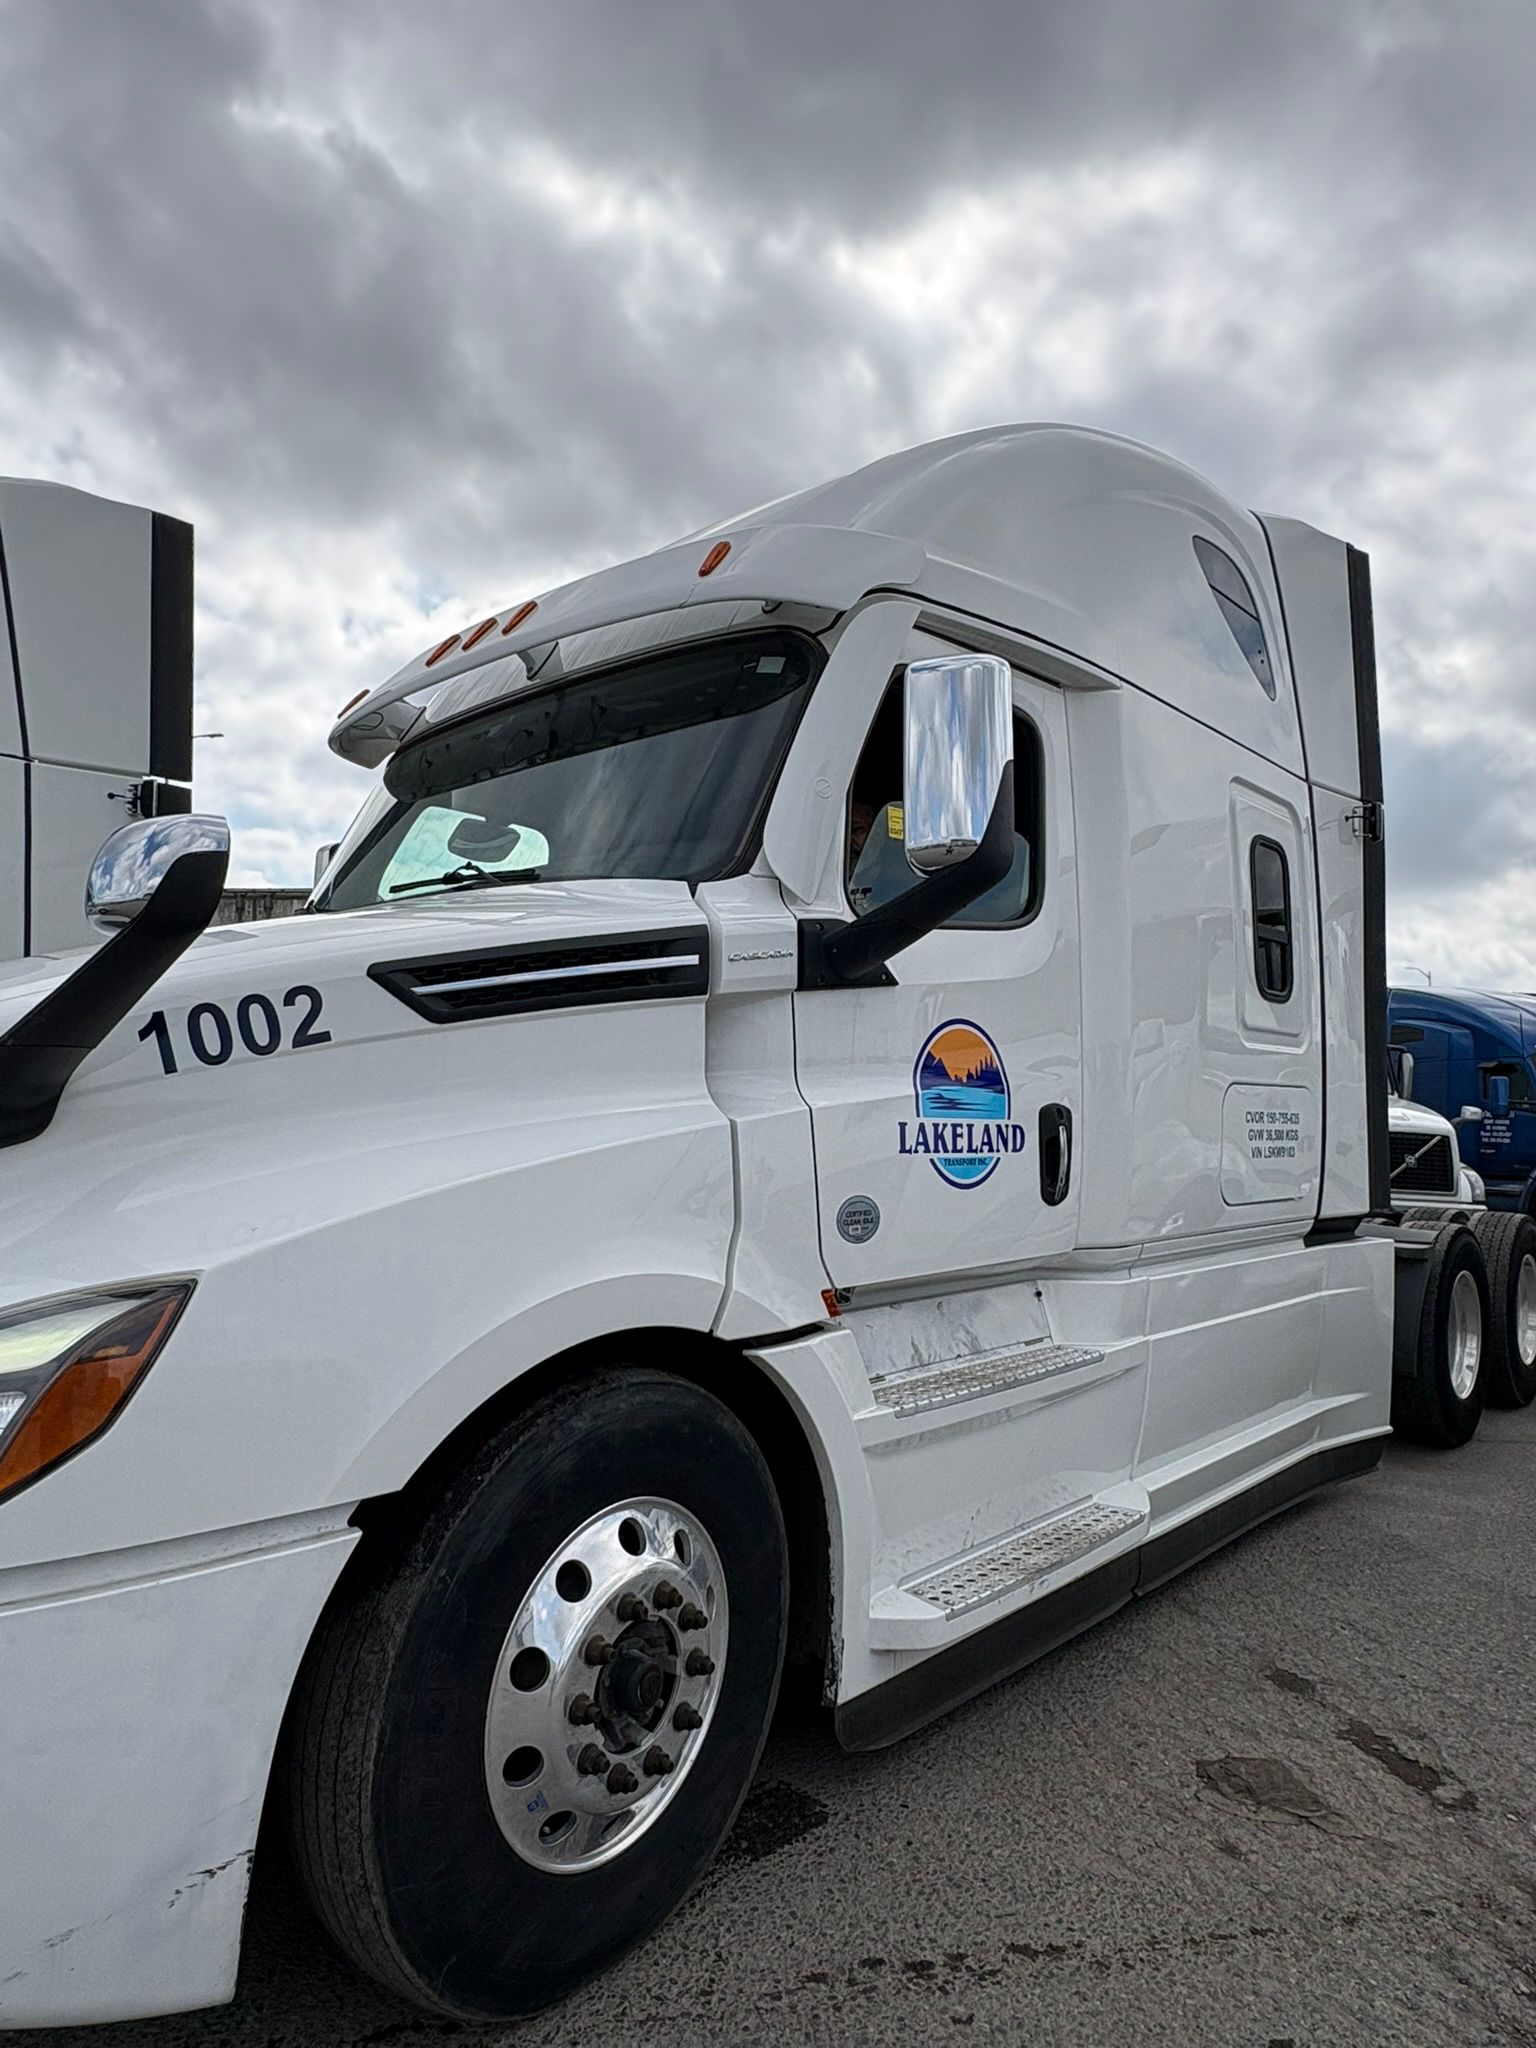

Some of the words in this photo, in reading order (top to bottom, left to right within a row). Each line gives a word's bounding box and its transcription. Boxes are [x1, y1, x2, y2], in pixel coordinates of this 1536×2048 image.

[728, 949, 794, 962] CASCADIA
[137, 985, 332, 1075] 1002
[1245, 1111, 1265, 1124] CVOR
[898, 1122, 1026, 1155] LAKELAND
[1248, 1129, 1264, 1141] GVW
[1286, 1129, 1299, 1141] KGS
[1251, 1146, 1263, 1159] VIN
[943, 1157, 977, 1167] TRANSPORT
